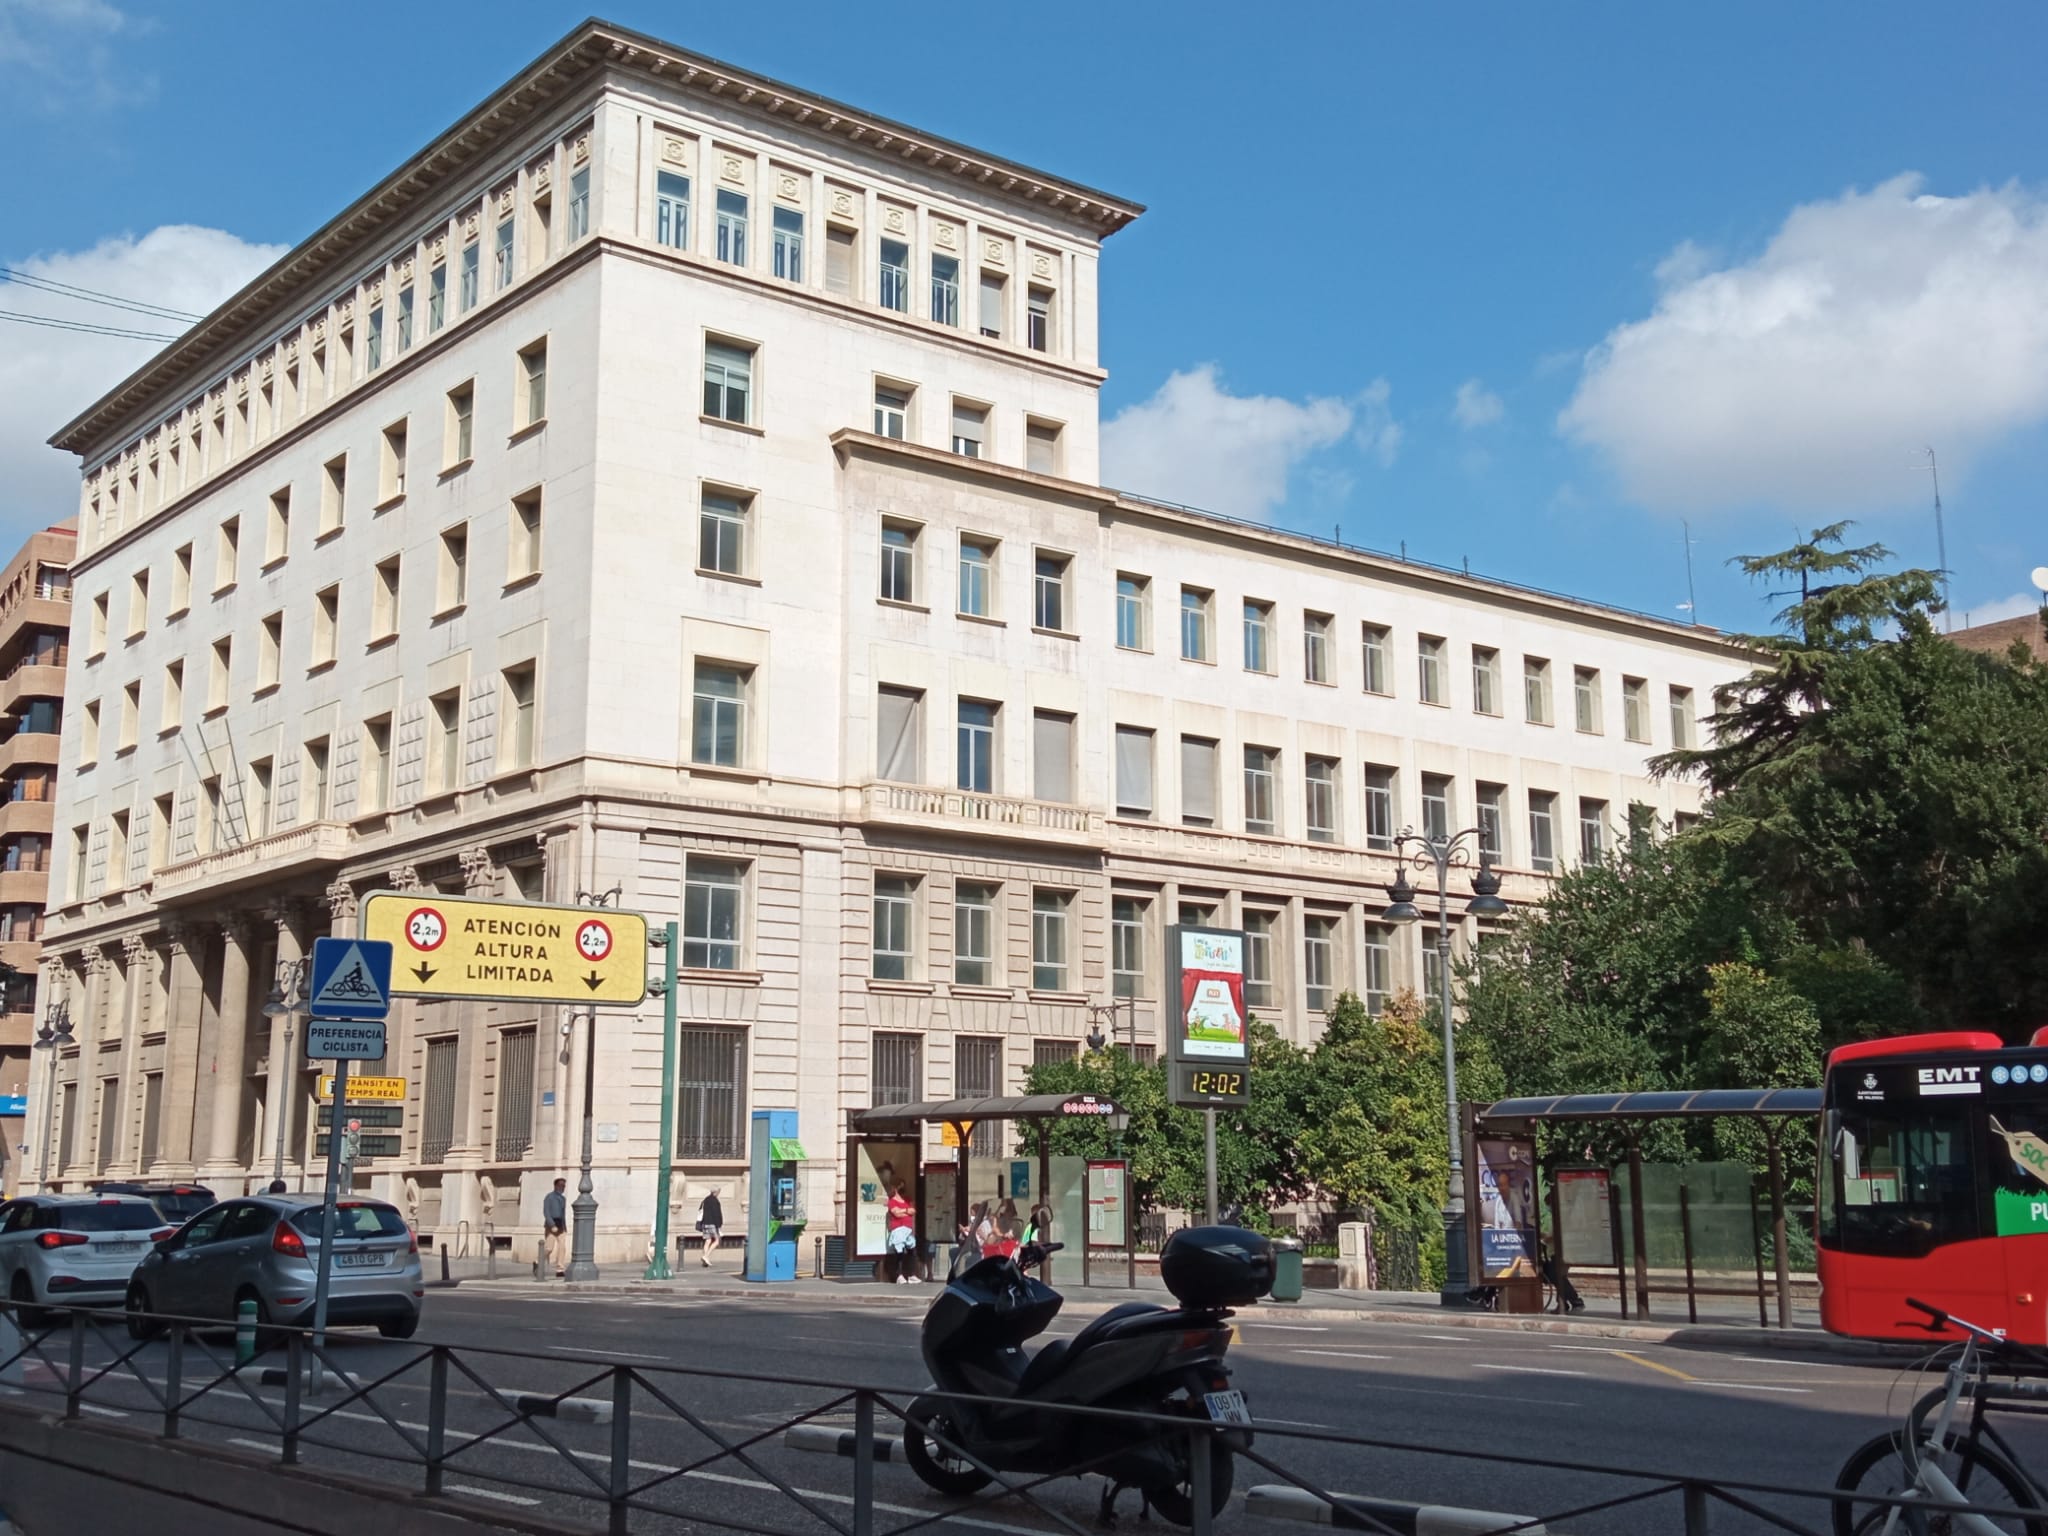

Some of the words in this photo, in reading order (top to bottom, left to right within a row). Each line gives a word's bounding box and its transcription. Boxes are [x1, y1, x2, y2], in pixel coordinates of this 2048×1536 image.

[464, 918, 560, 938] ATENCIÓN
[474, 942, 548, 960] ALTURA
[467, 964, 554, 983] LIMITADA
[311, 1028, 382, 1039] PREFERENCIA
[322, 1041, 369, 1052] CICLISTA
[1918, 1067, 1981, 1083] EMT
[387, 1080, 399, 1088] EN
[1192, 1073, 1240, 1094] 12:02
[345, 1088, 374, 1097] TEMPS
[377, 1090, 400, 1098] REAL
